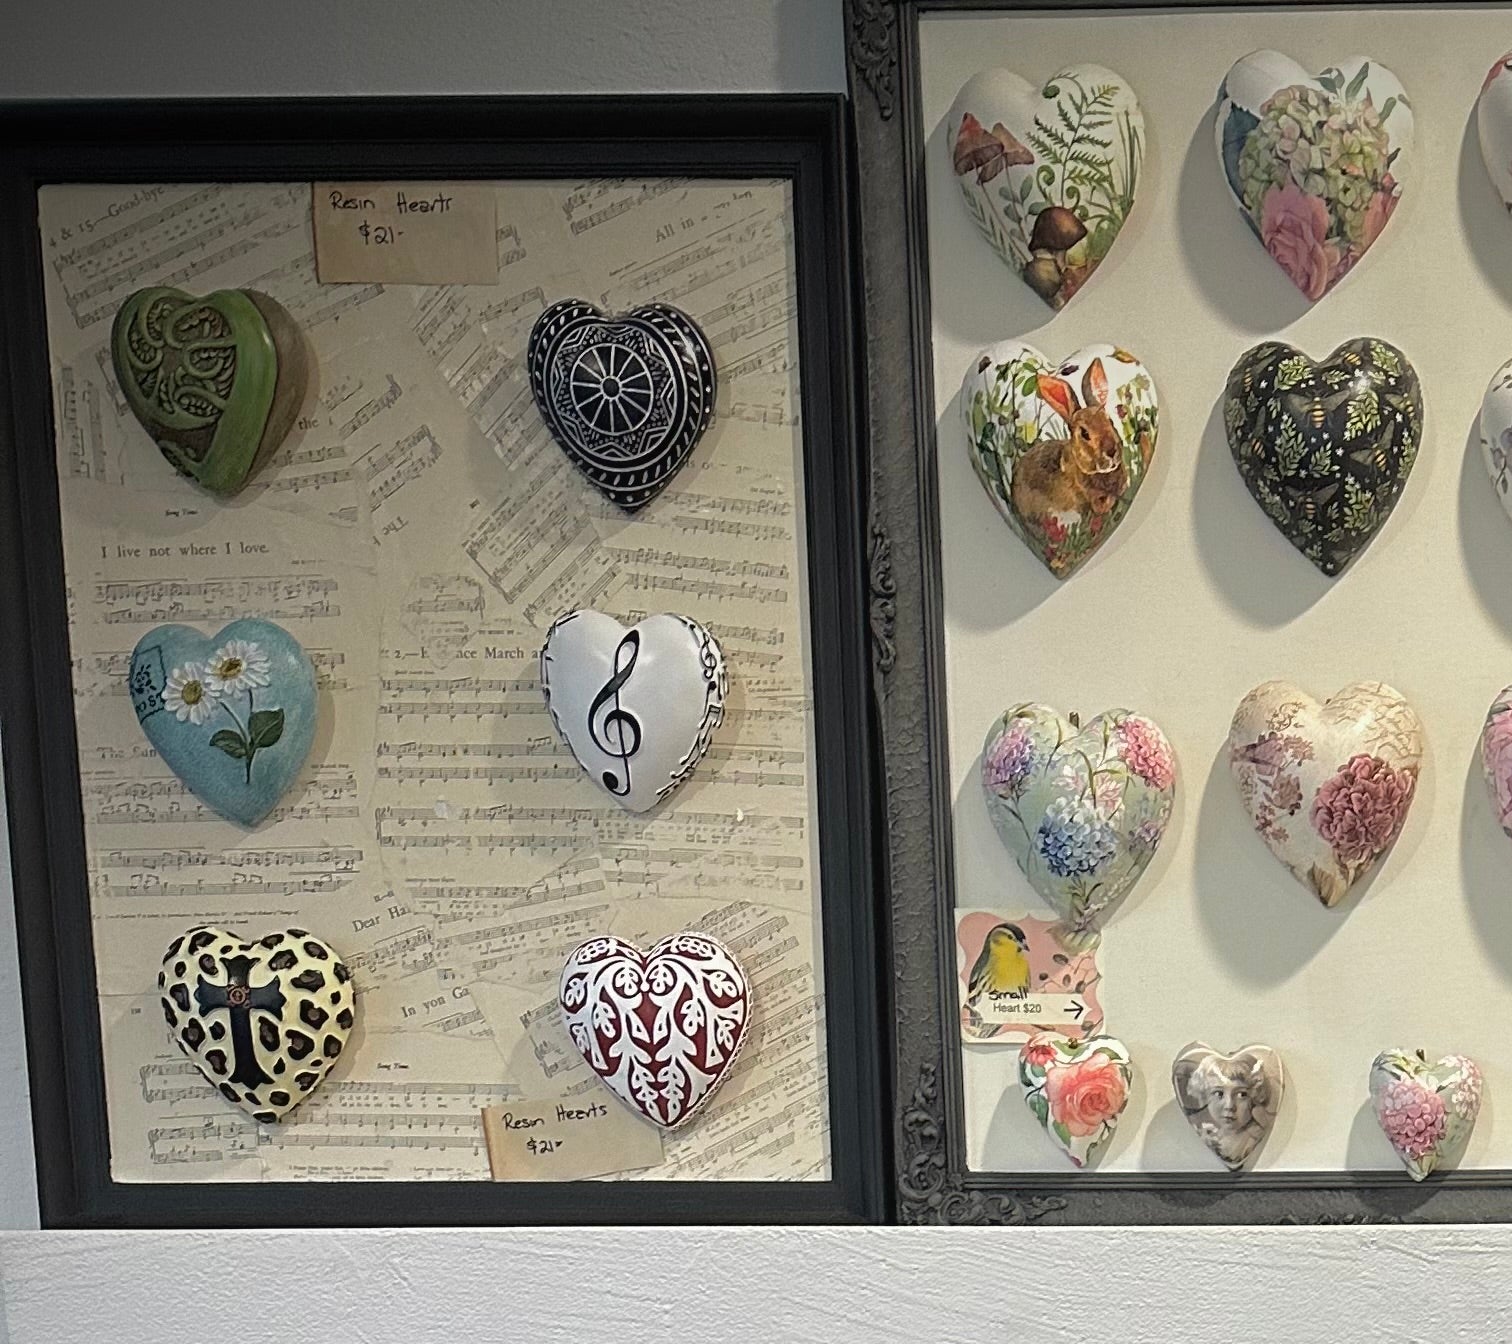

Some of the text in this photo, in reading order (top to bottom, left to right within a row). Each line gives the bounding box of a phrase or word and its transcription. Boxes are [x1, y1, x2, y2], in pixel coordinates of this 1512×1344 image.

[328, 189, 454, 214] Resin Hearts
[655, 223, 676, 243] All
[101, 546, 107, 559] I
[117, 545, 142, 558] live
[150, 546, 171, 558] not
[178, 542, 218, 556] where
[225, 541, 231, 555] I
[485, 645, 524, 660] March
[352, 915, 381, 933] Dear
[401, 1005, 417, 1018] In
[422, 995, 446, 1014] yon
[993, 1002, 1042, 1013] Heart $20
[555, 1102, 608, 1122] Hearts
